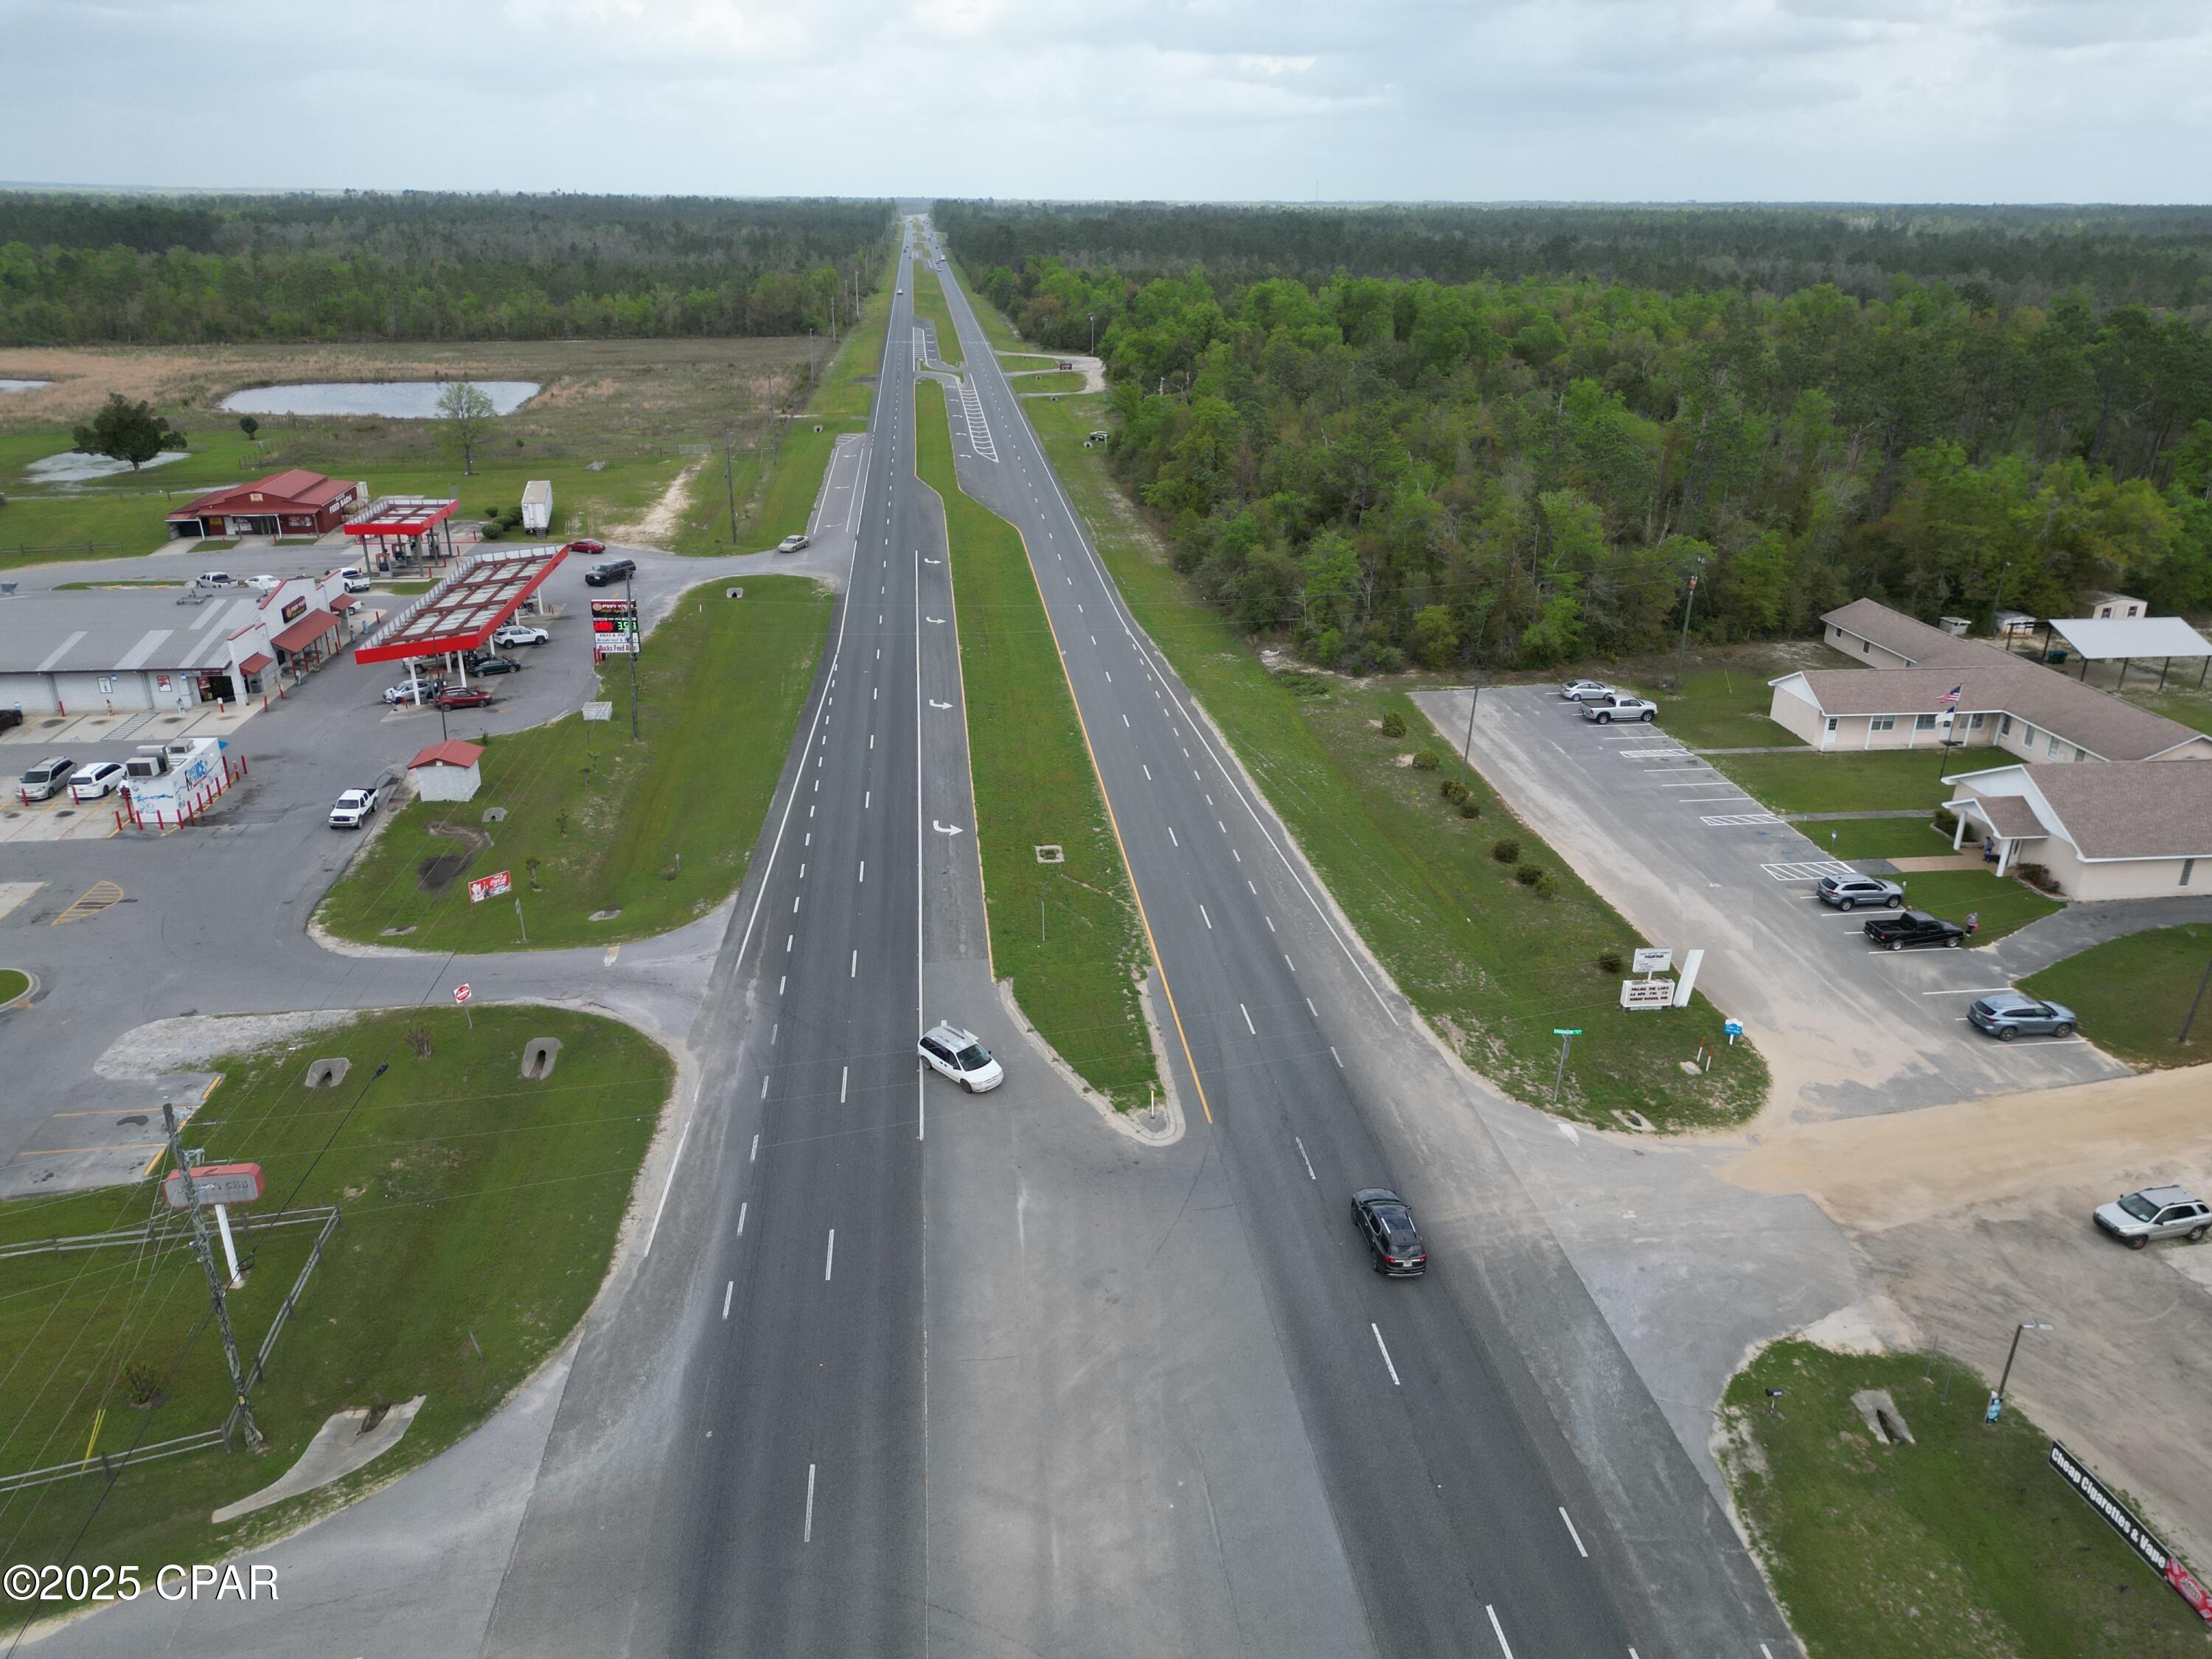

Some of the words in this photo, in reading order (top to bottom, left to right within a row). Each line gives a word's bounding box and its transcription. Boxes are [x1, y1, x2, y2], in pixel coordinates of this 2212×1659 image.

[329, 502, 340, 514] FEED
[340, 494, 352, 507] BARN
[2051, 1447, 2081, 1484] Cheap
[2080, 1476, 2132, 1533] Cigarettes
[2130, 1528, 2139, 1543] &
[2139, 1534, 2166, 1569] Vape
